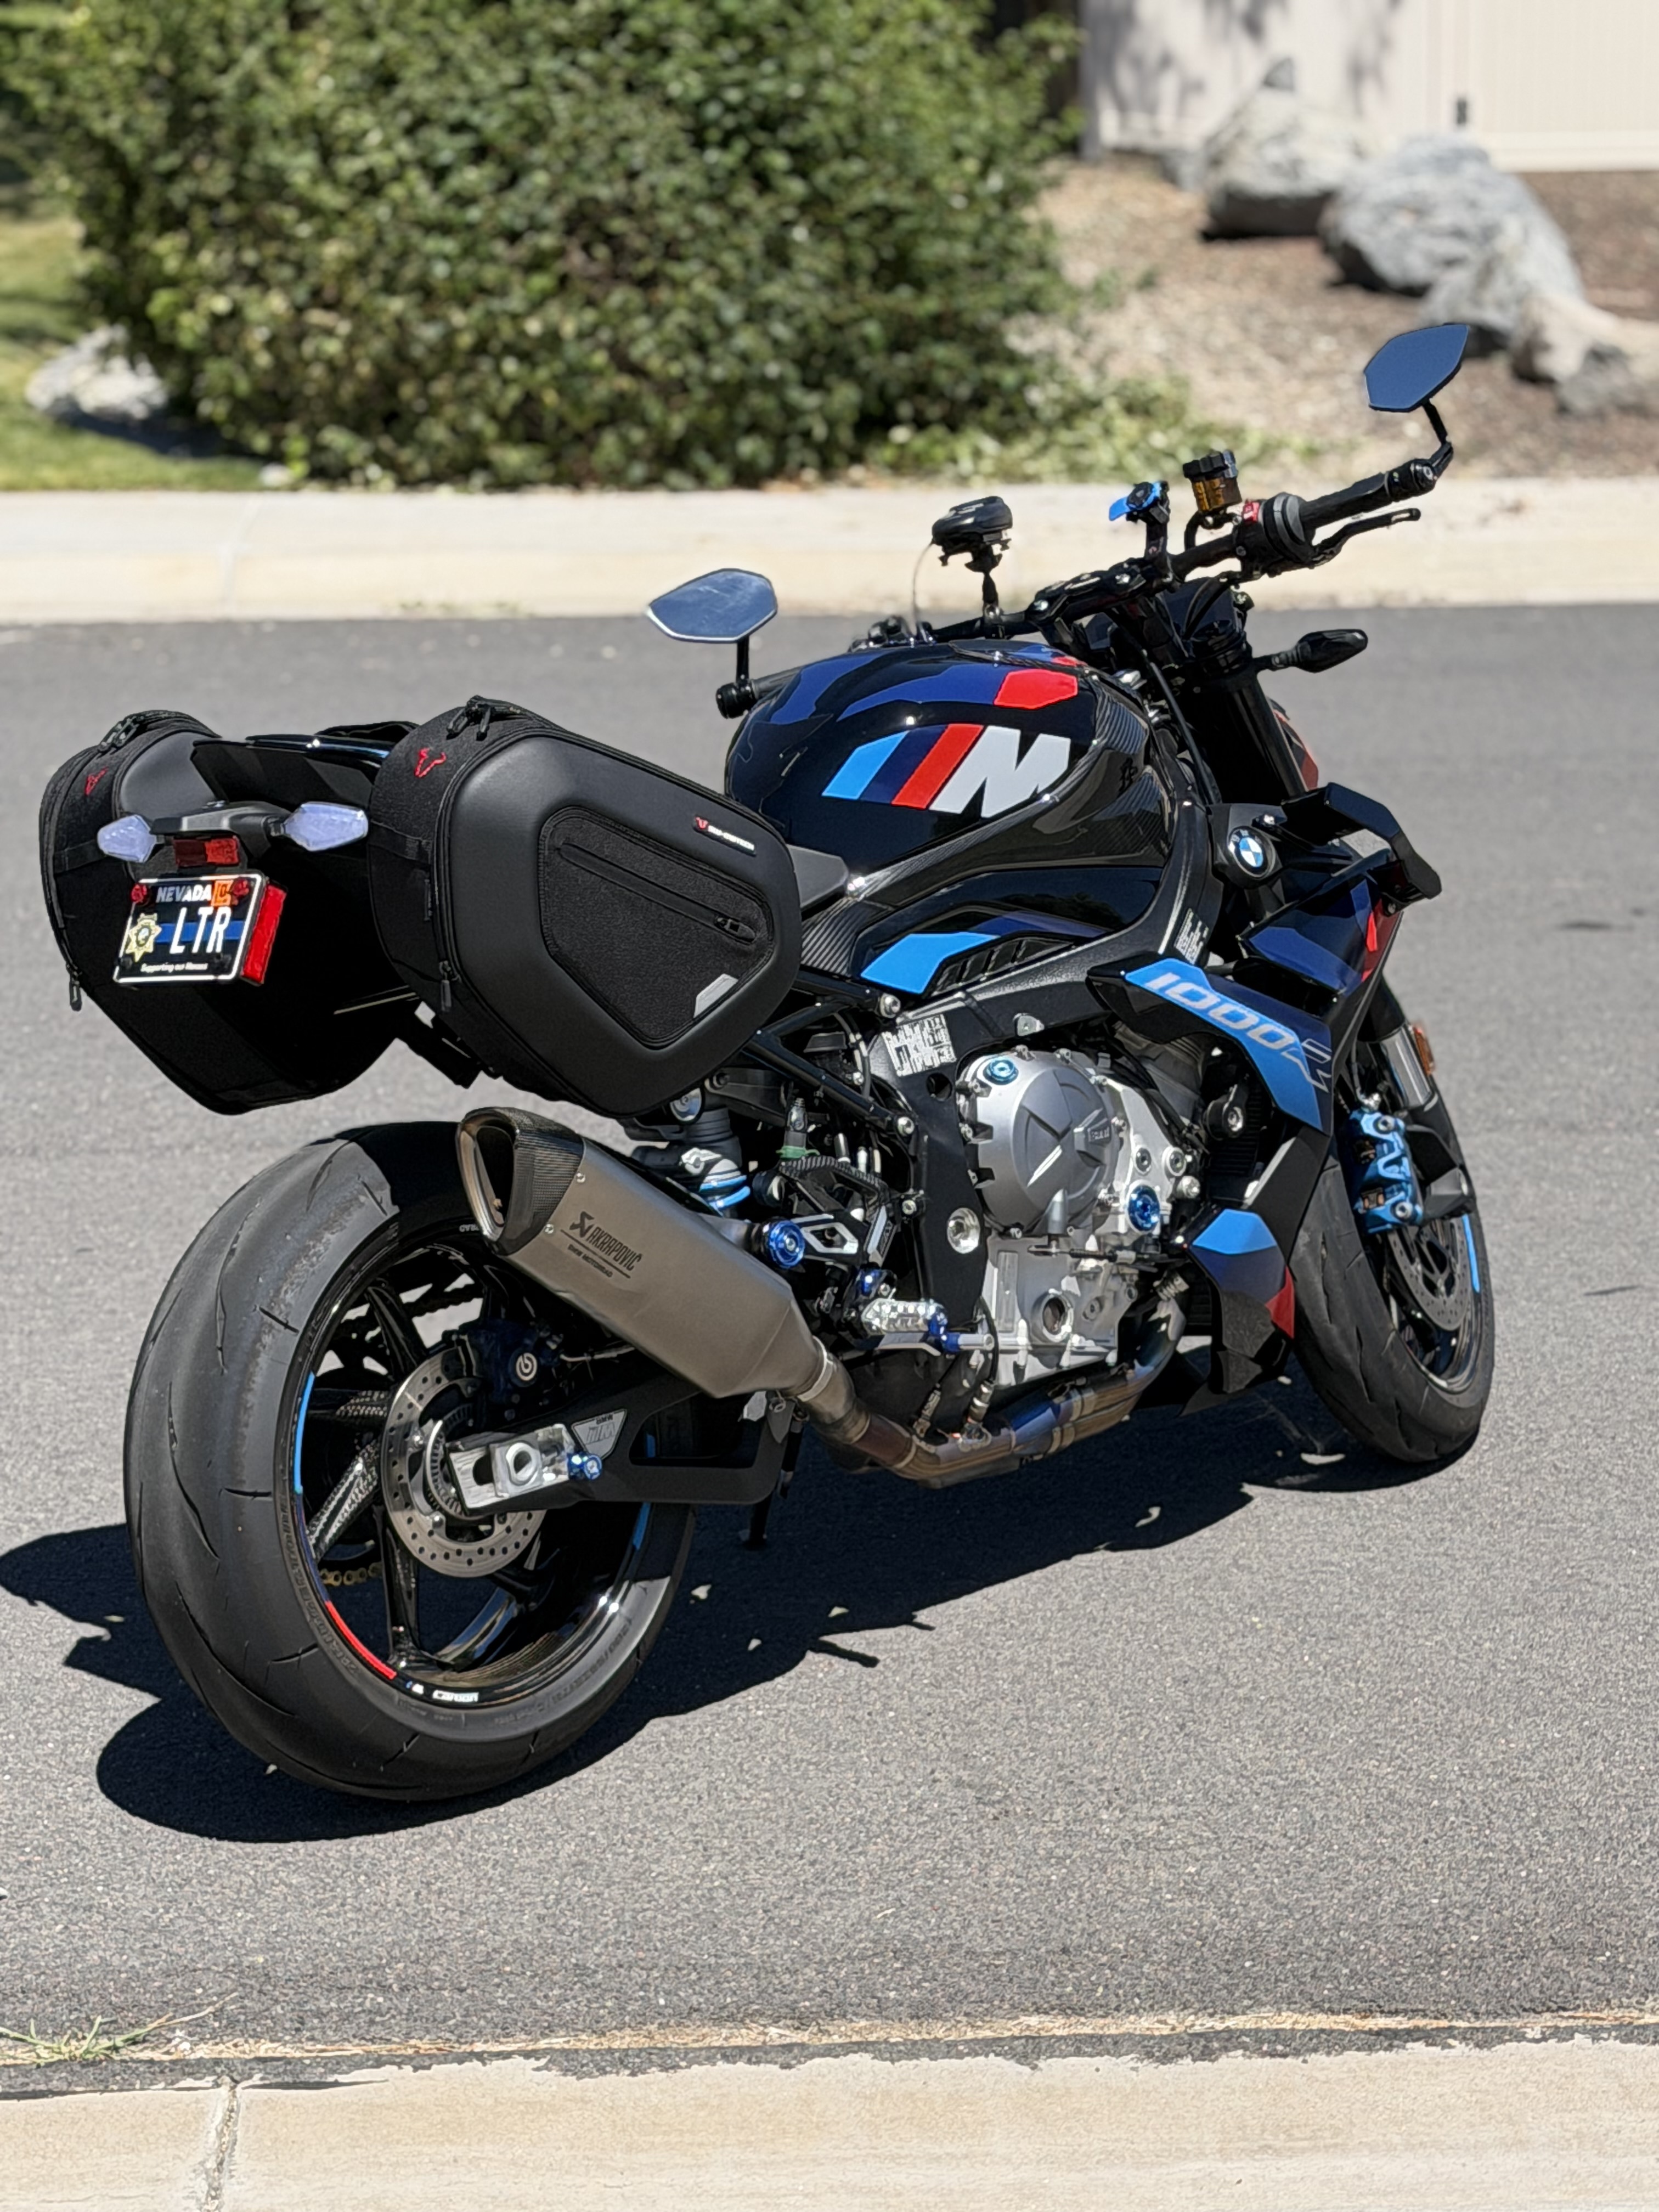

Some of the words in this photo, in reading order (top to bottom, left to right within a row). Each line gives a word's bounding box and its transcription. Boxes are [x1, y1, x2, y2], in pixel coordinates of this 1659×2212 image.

[929, 725, 1071, 819] M
[156, 884, 212, 903] NEVADA
[170, 906, 232, 954] LTR
[1143, 972, 1297, 1050] 1000
[585, 1227, 642, 1271] AKRAPOVIČ
